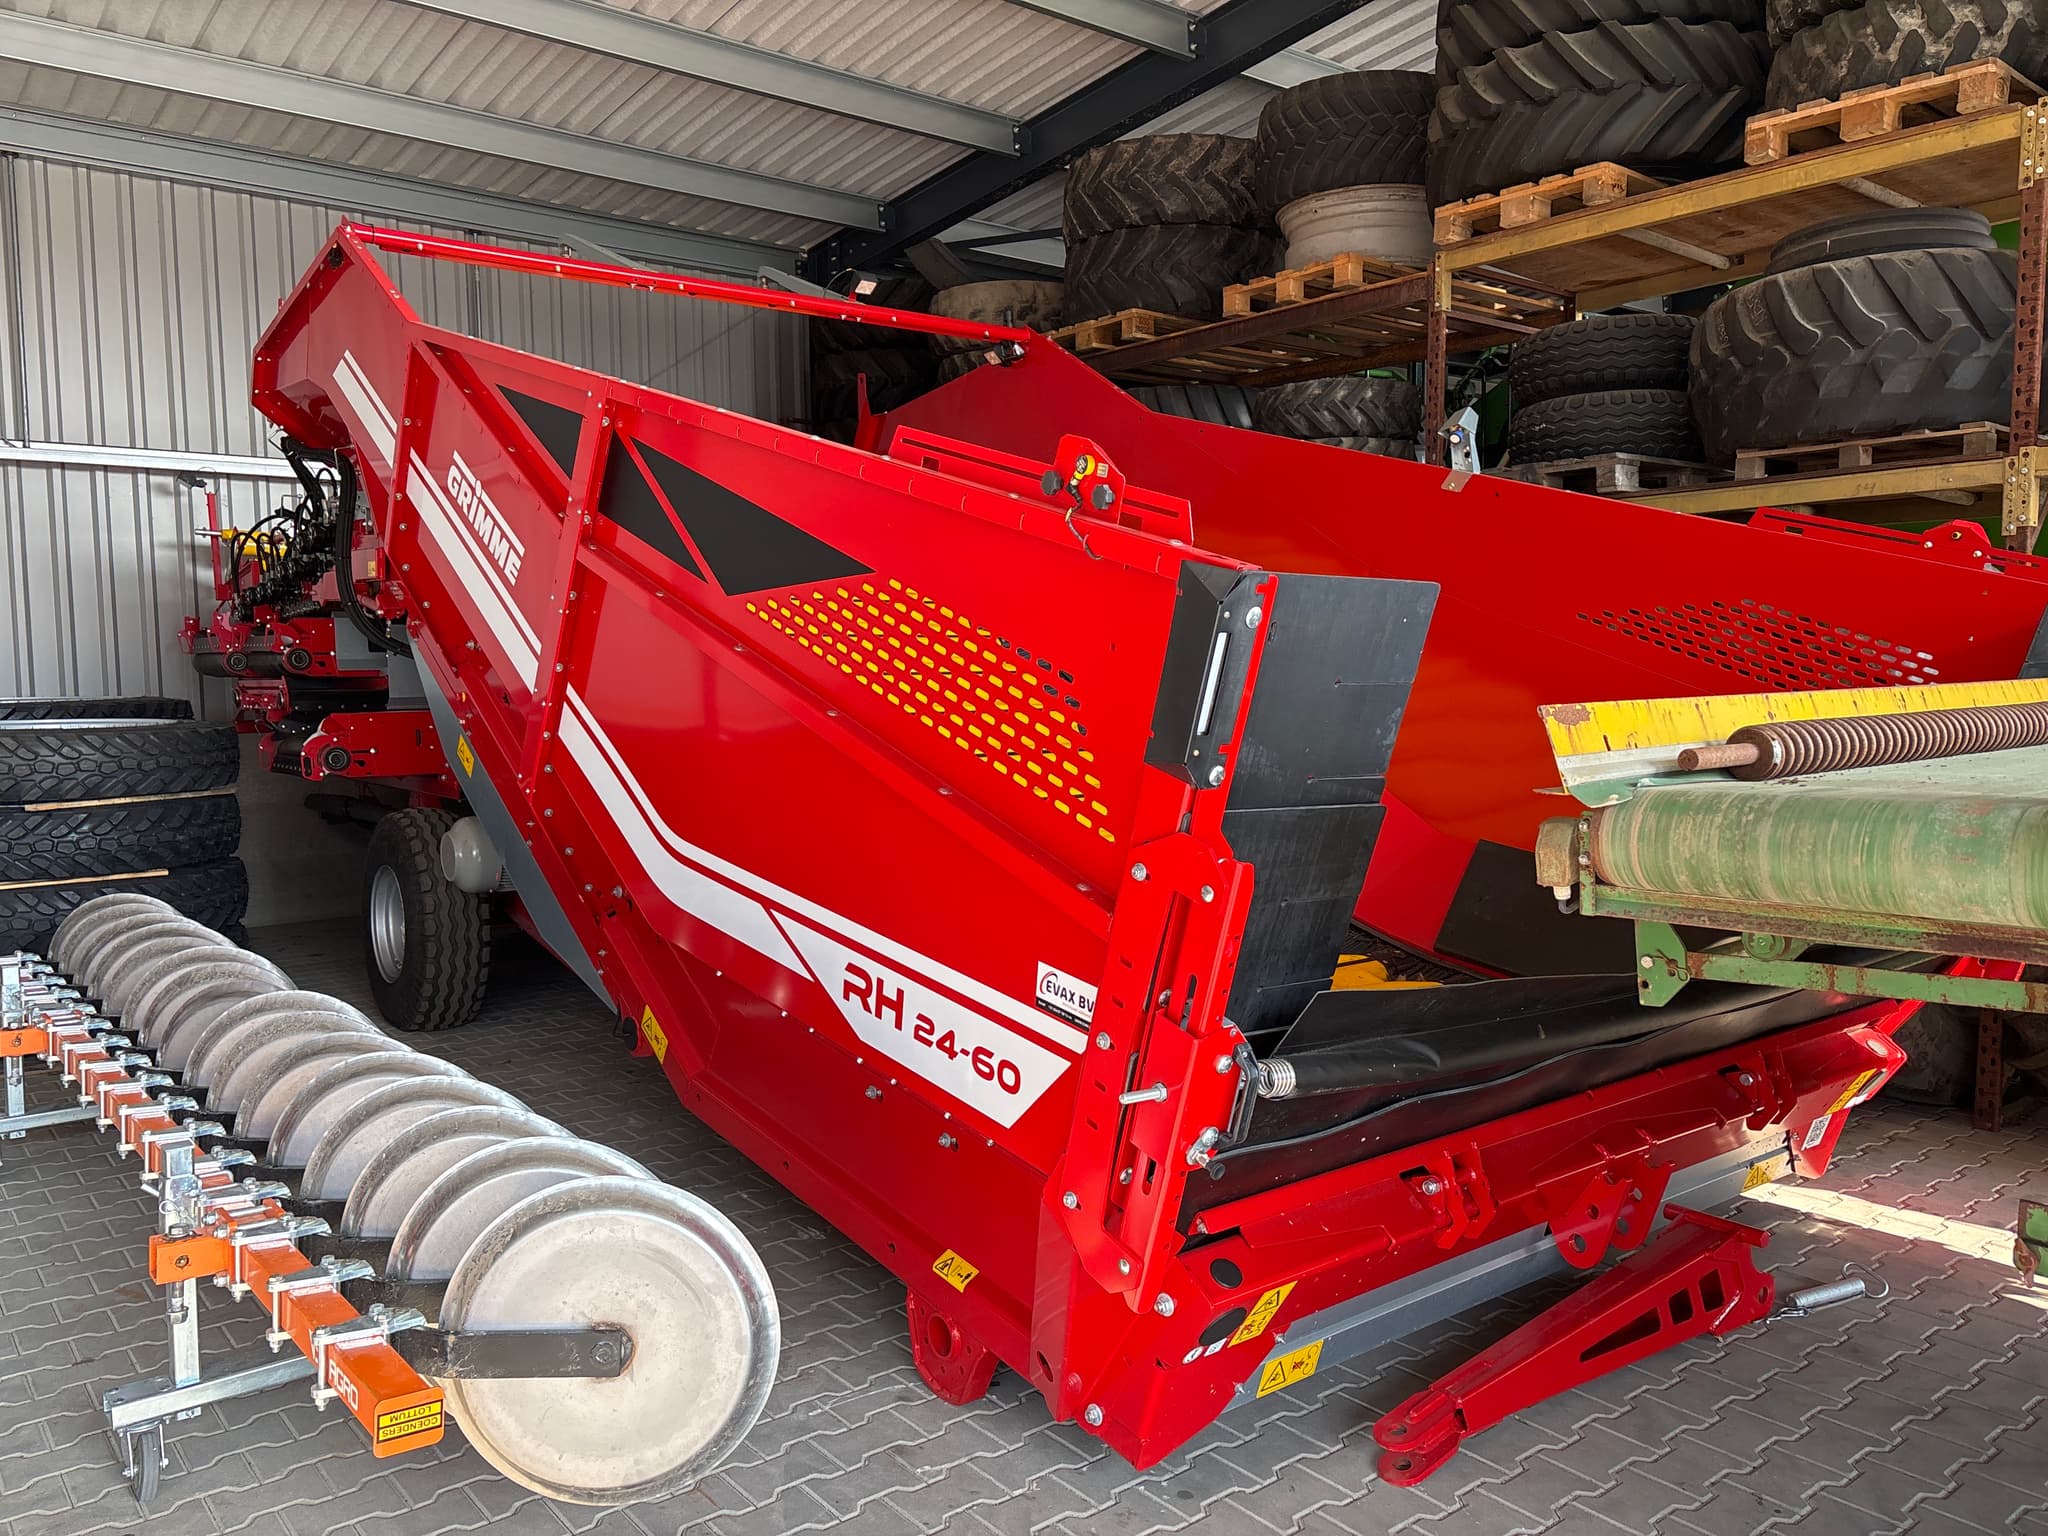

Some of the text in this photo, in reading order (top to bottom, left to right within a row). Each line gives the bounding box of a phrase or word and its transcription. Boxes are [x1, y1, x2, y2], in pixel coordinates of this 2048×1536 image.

[447, 464, 522, 587] GRIMME
[1045, 979, 1076, 1006] EVAX
[1078, 994, 1095, 1014] BV
[842, 961, 1021, 1095] RH 24-60
[328, 1358, 359, 1412] AGRO
[381, 1416, 438, 1438] COENDERS
[389, 1405, 432, 1423] LOTTUM
